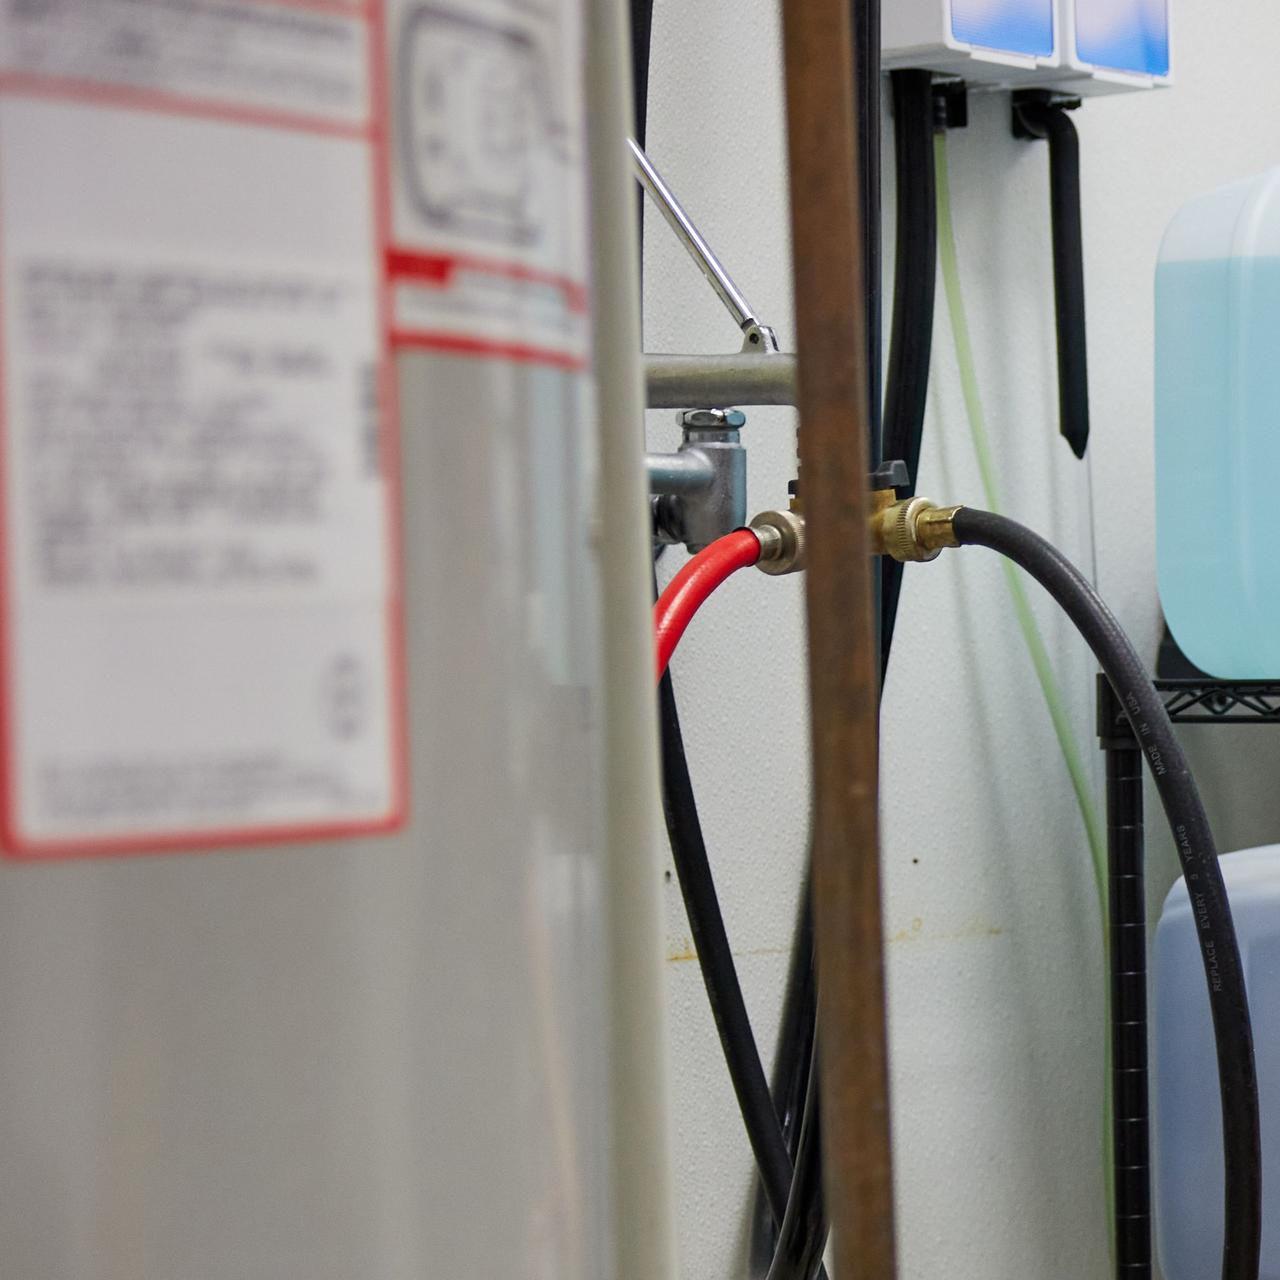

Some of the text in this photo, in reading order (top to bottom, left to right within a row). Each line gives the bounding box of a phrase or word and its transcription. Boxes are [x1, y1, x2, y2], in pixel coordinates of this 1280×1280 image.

[1126, 691, 1142, 715] USA
[1139, 723, 1150, 736] IN
[1147, 744, 1167, 776] MADE
[1177, 825, 1194, 862] YEARS
[1195, 892, 1210, 929] EVERY
[1205, 940, 1223, 992] REPLACE
